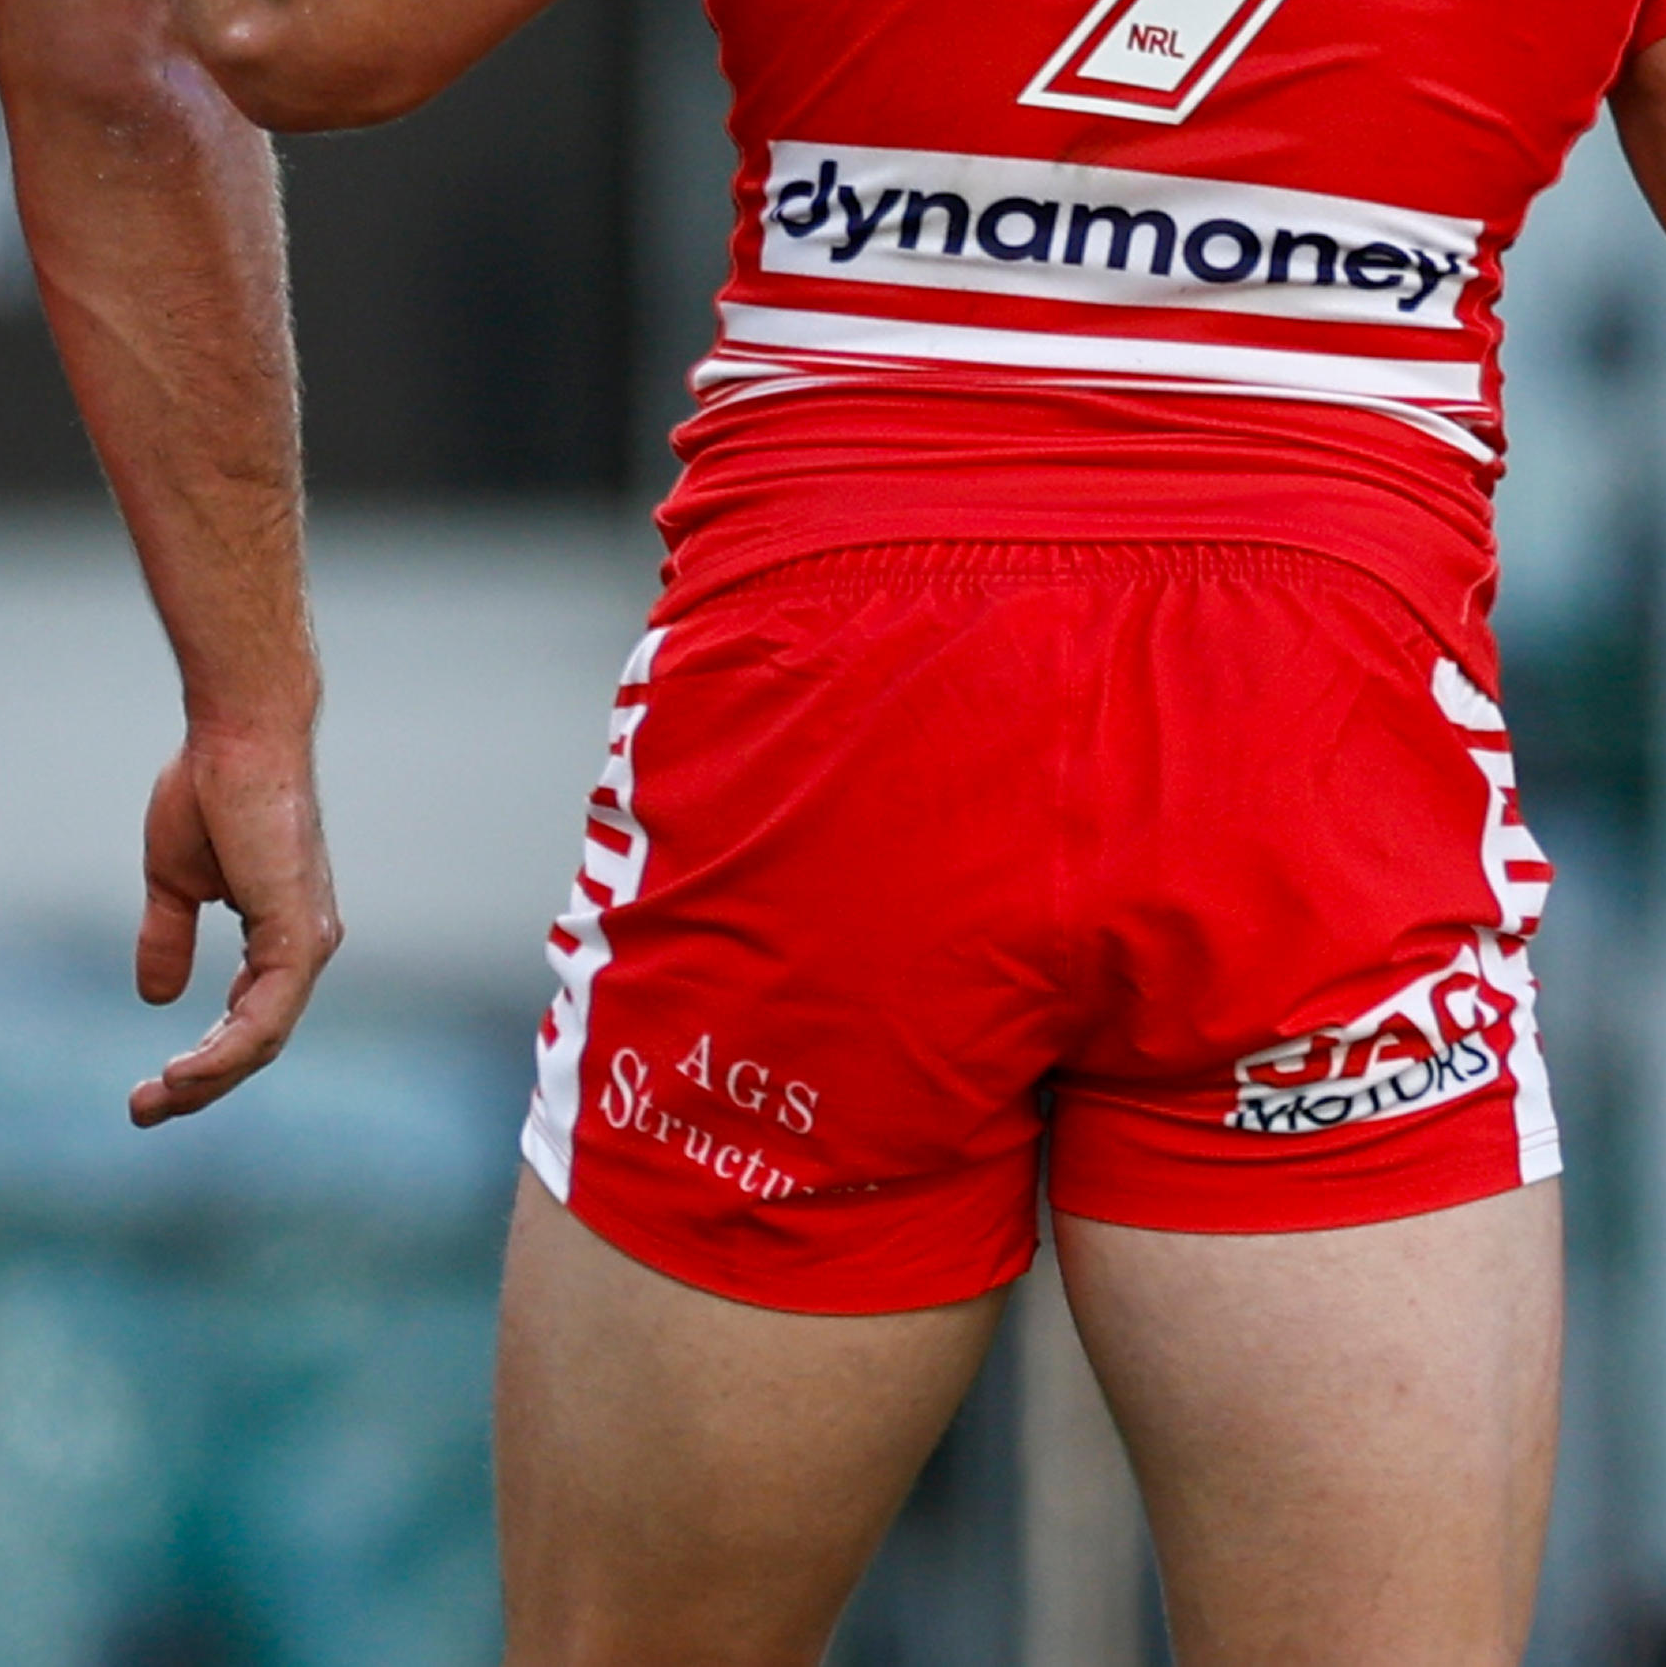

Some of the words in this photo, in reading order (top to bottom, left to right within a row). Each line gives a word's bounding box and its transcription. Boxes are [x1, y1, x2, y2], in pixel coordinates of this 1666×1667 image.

[1126, 23, 1186, 60] NRL
[770, 159, 1463, 313] dynamoney
[599, 1046, 880, 1201] Structu
[675, 1032, 820, 1135] AGS
